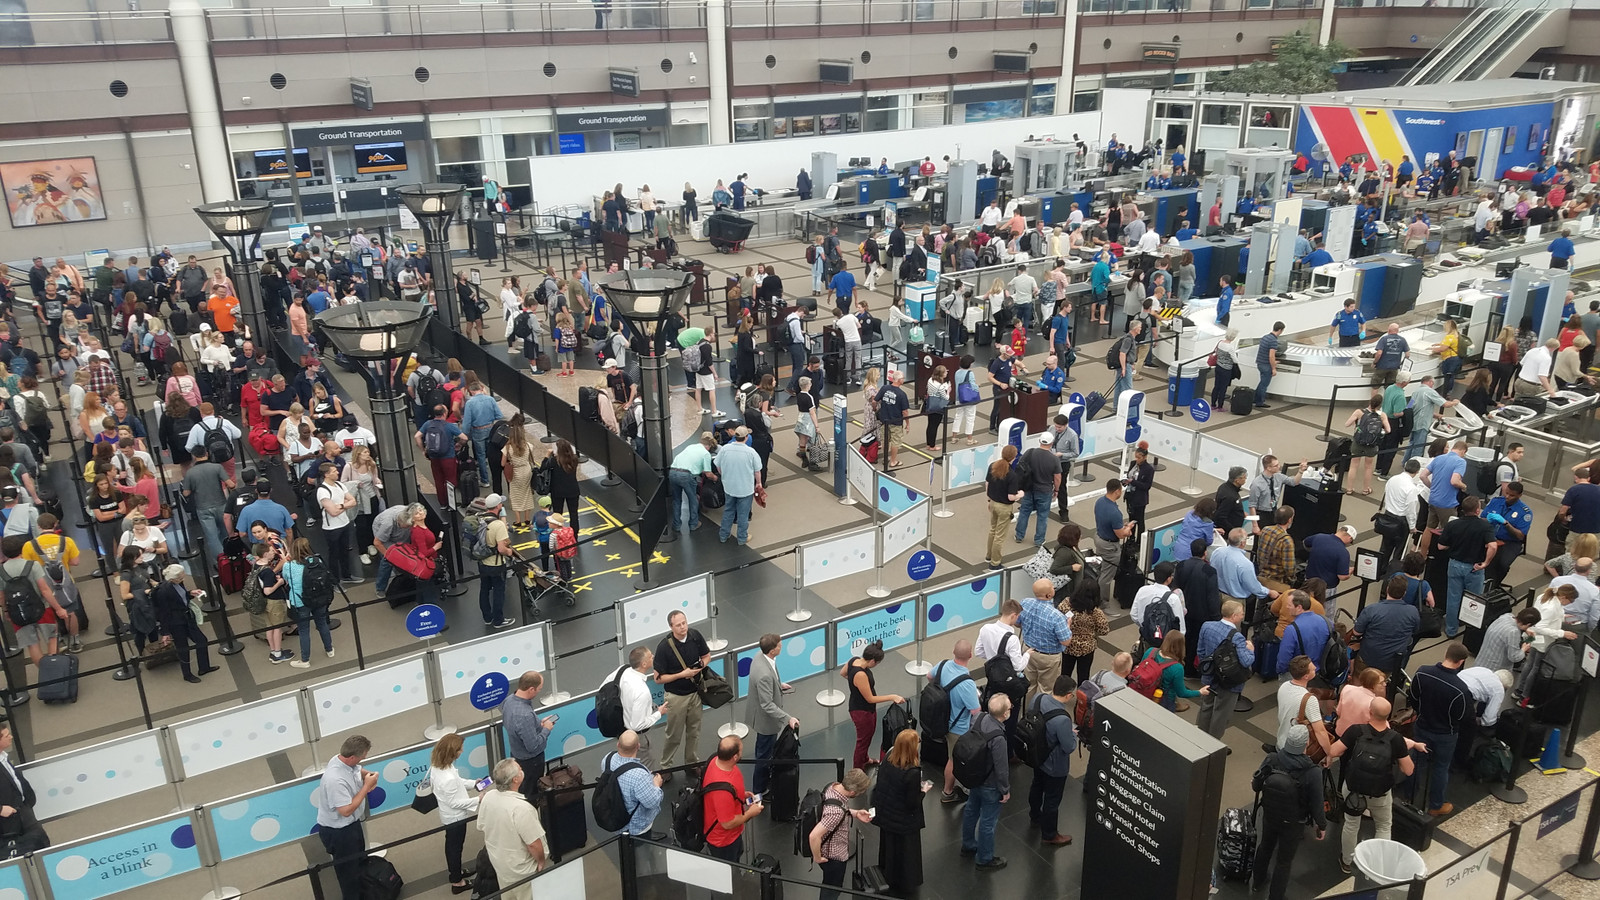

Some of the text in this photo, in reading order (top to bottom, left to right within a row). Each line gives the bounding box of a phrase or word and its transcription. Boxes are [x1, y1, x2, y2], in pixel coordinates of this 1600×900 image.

[579, 115, 647, 125] Ground Transportation
[1406, 117, 1441, 125] Southwest
[319, 129, 402, 140] Ground Transportation
[846, 614, 907, 640] You're the best
[851, 628, 902, 650] ID out there
[1112, 744, 1140, 768] Ground
[1111, 765, 1153, 799] Information
[1112, 754, 1167, 797] Transportation
[1109, 778, 1165, 822] Baggage Claim
[1109, 793, 1156, 831] Westin Hotel
[1108, 807, 1159, 849] Transit Center
[88, 842, 158, 869] Access in
[1116, 828, 1160, 866] Food, Shops
[101, 857, 152, 880] a blink
[1446, 872, 1460, 888] TSA
